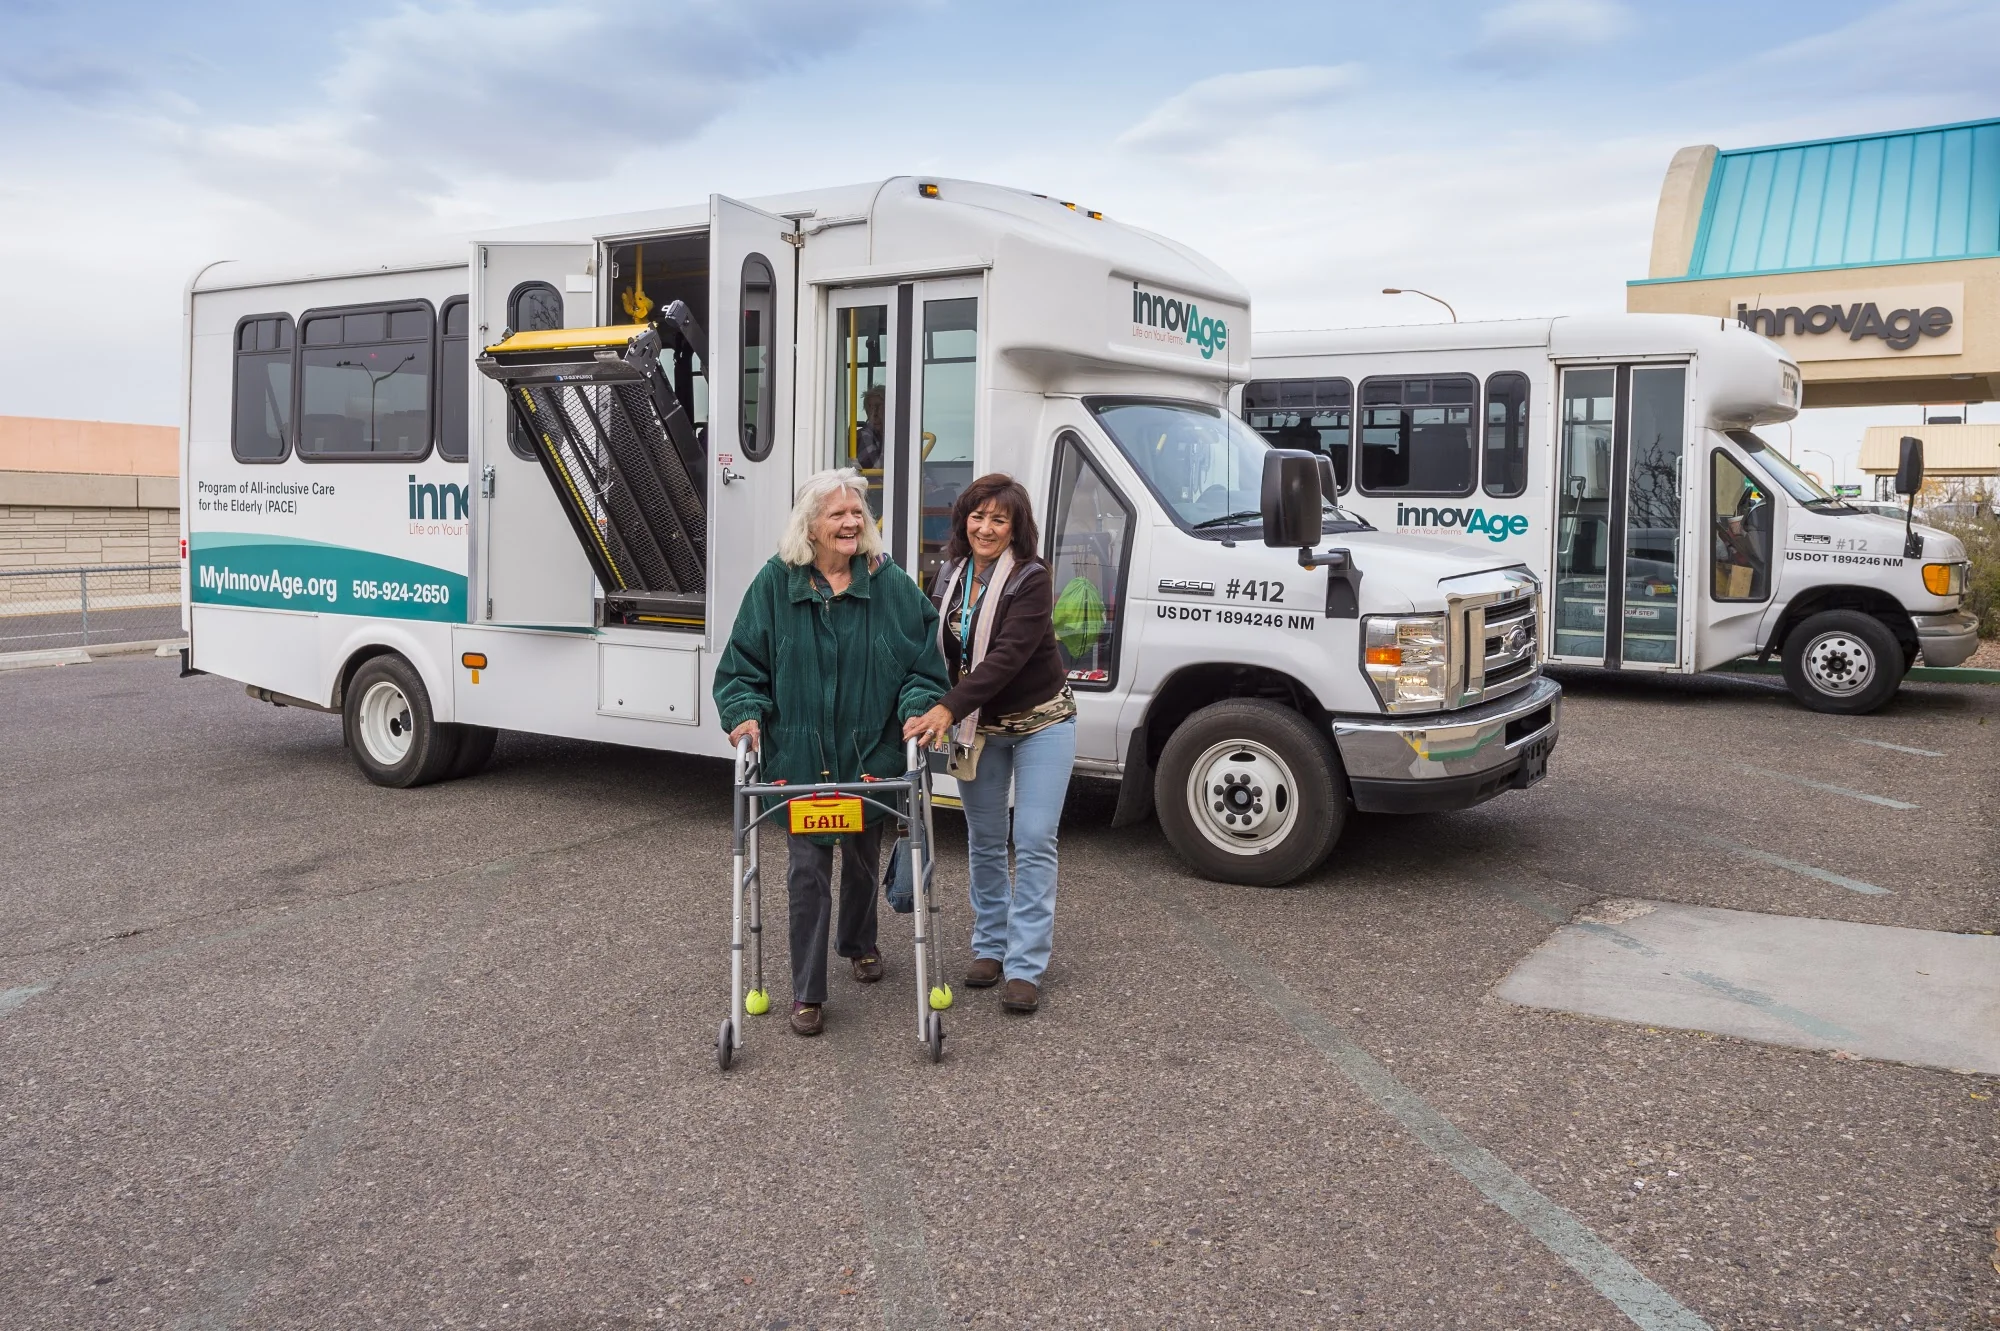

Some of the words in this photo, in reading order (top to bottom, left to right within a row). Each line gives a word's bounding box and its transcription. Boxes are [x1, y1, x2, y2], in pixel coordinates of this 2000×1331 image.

[1132, 281, 1227, 360] innovAge
[1737, 303, 1954, 351] innovAge
[1132, 325, 1143, 337] Life
[1144, 329, 1152, 339] on
[1153, 330, 1166, 342] Your
[1167, 332, 1184, 345] Terms
[198, 480, 237, 496] Program
[240, 481, 249, 494] of
[251, 481, 309, 495] All-inclusive
[312, 482, 335, 495] Care
[198, 499, 211, 511] for
[213, 499, 228, 511] the
[231, 499, 262, 515] Elderly
[265, 500, 297, 515] (PACE)
[409, 523, 425, 535] Life
[427, 525, 440, 535] on
[442, 523, 463, 536] Your
[1396, 502, 1529, 543] innovAge
[1396, 527, 1409, 535] Life
[1440, 528, 1462, 536] Terms
[1836, 539, 1868, 552] #12
[1832, 555, 1880, 566] 1894246
[1883, 557, 1904, 567] NM
[199, 565, 337, 602] MyInnovAge.org
[352, 580, 450, 604] 505-924-2650
[1226, 578, 1285, 603] #412
[1216, 610, 1284, 628] 1894246
[1288, 615, 1315, 631] NM
[803, 814, 850, 829] GAIL
